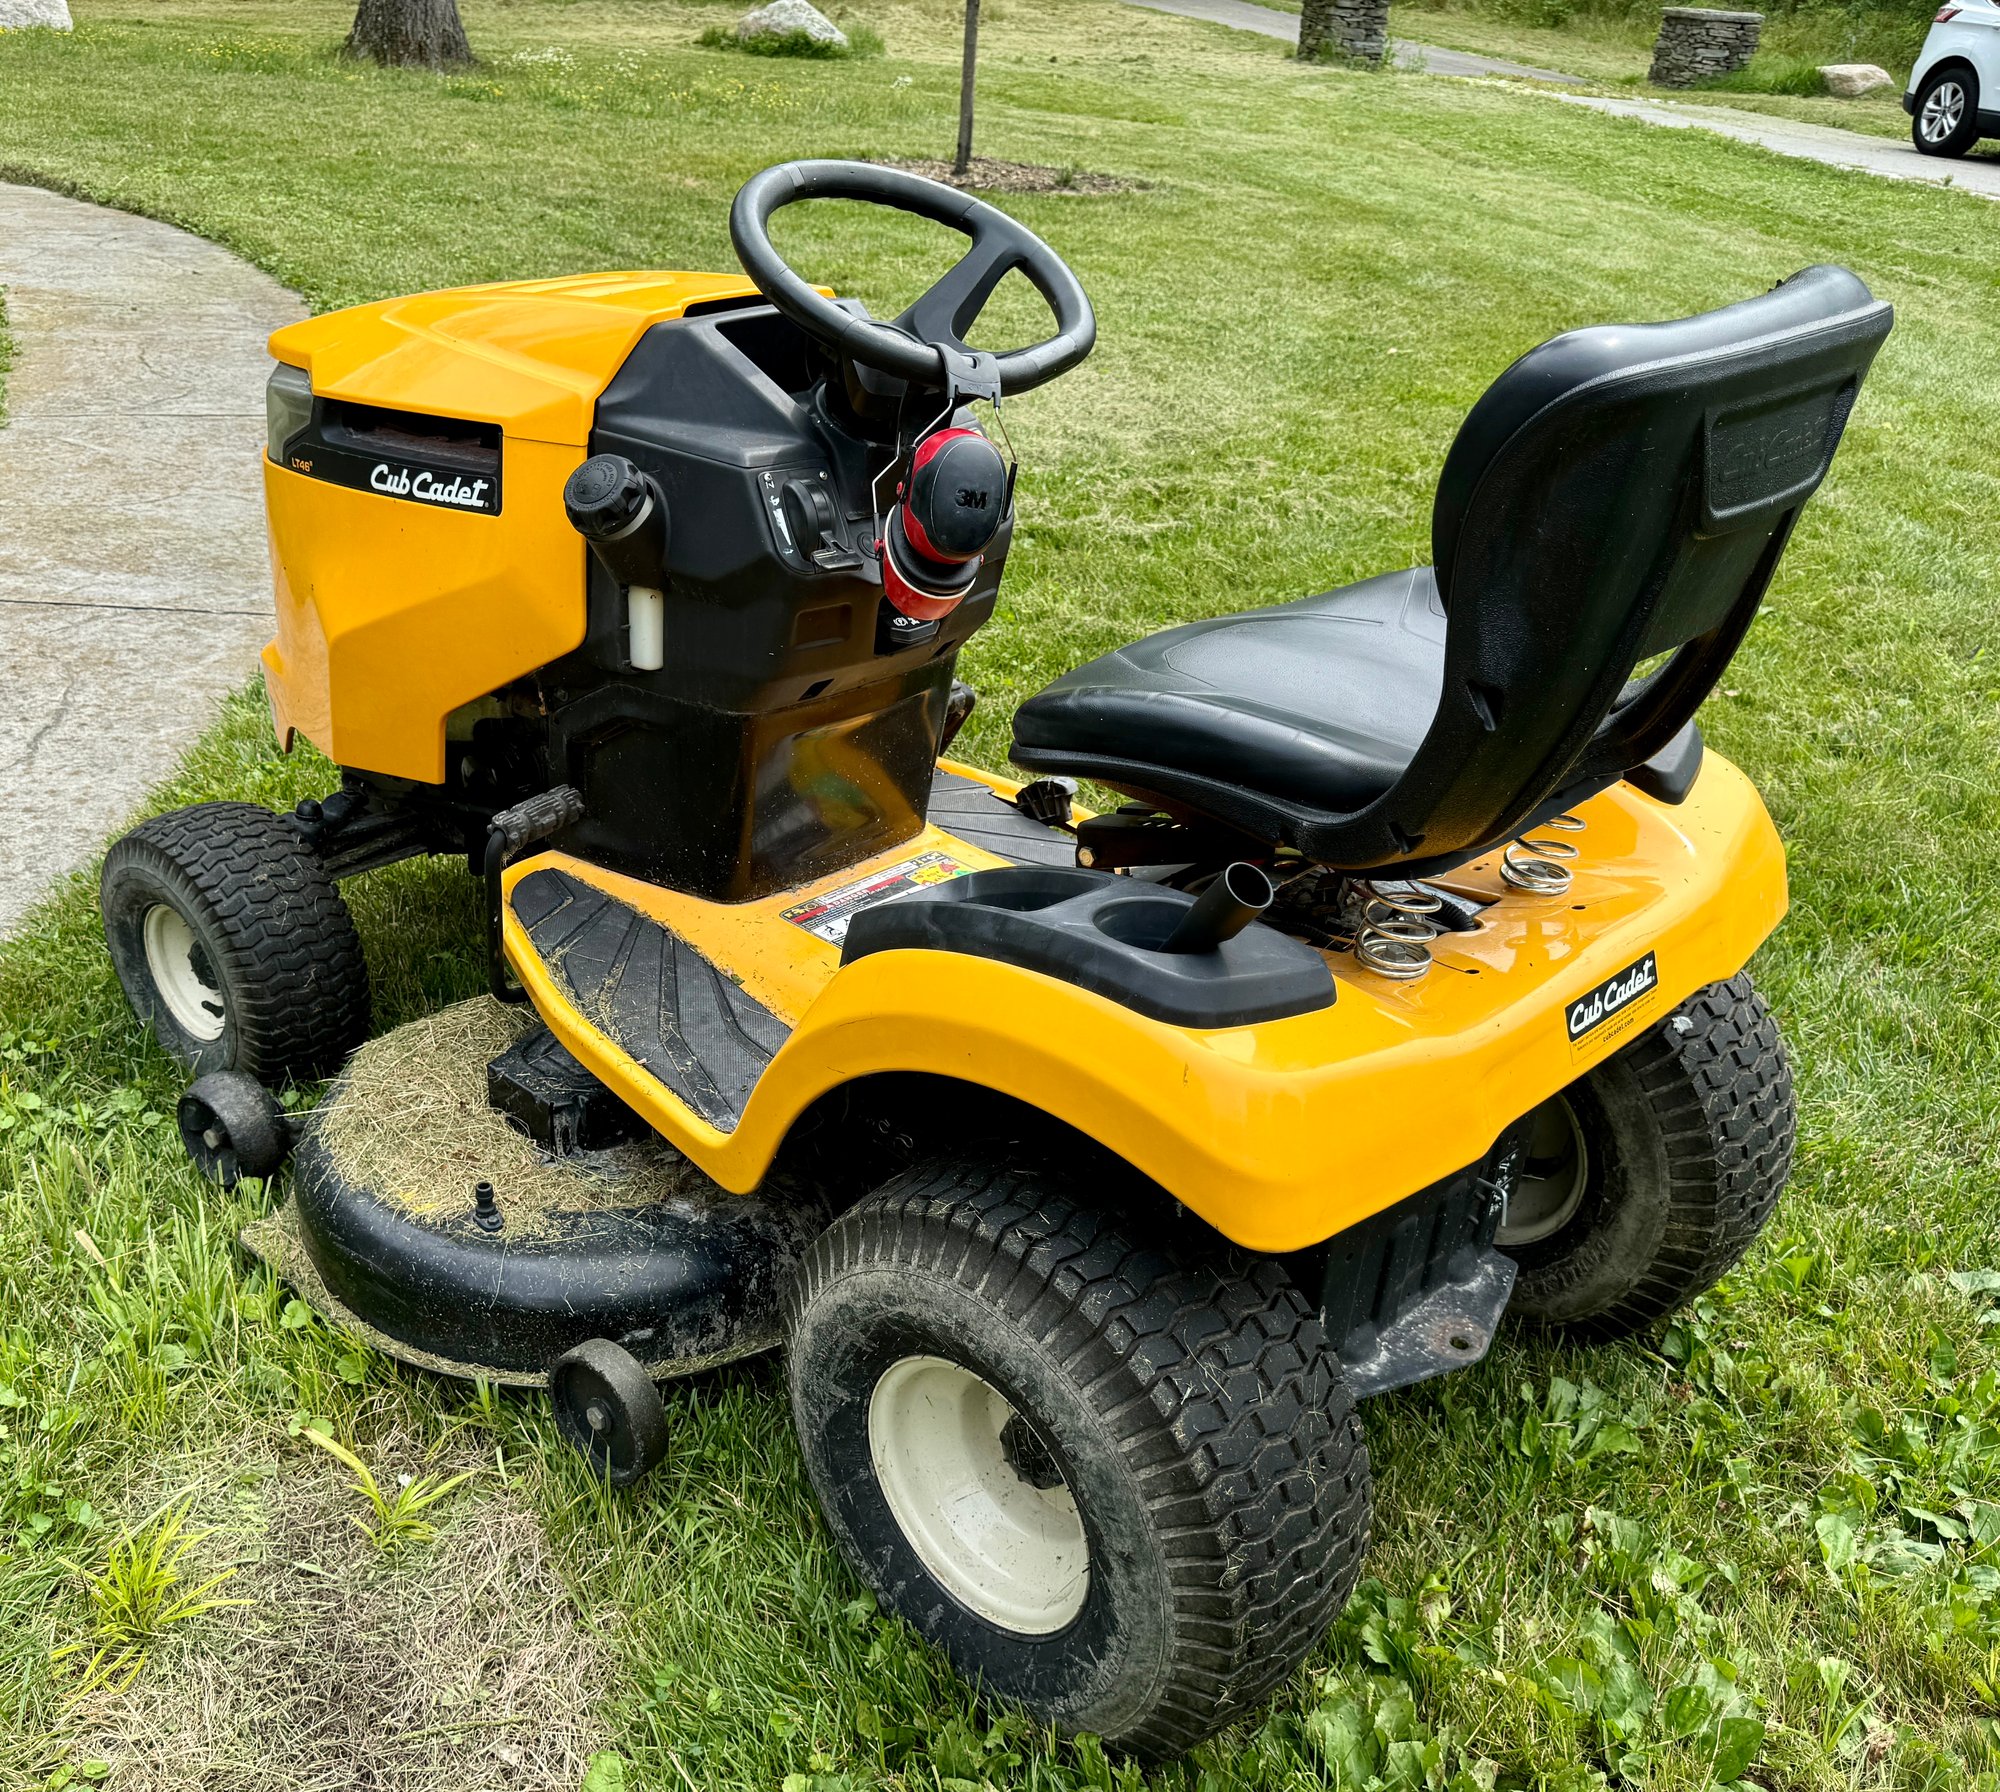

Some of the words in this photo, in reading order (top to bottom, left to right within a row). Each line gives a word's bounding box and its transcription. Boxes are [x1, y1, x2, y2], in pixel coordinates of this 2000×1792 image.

[370, 464, 411, 495] Cub
[412, 471, 489, 508] Cadet
[955, 488, 988, 511] 3M
[833, 889, 870, 906] DANGER
[1570, 993, 1603, 1034] Cub
[1604, 959, 1653, 1012] Cadet
[1603, 1018, 1635, 1042] cubcadet.com
